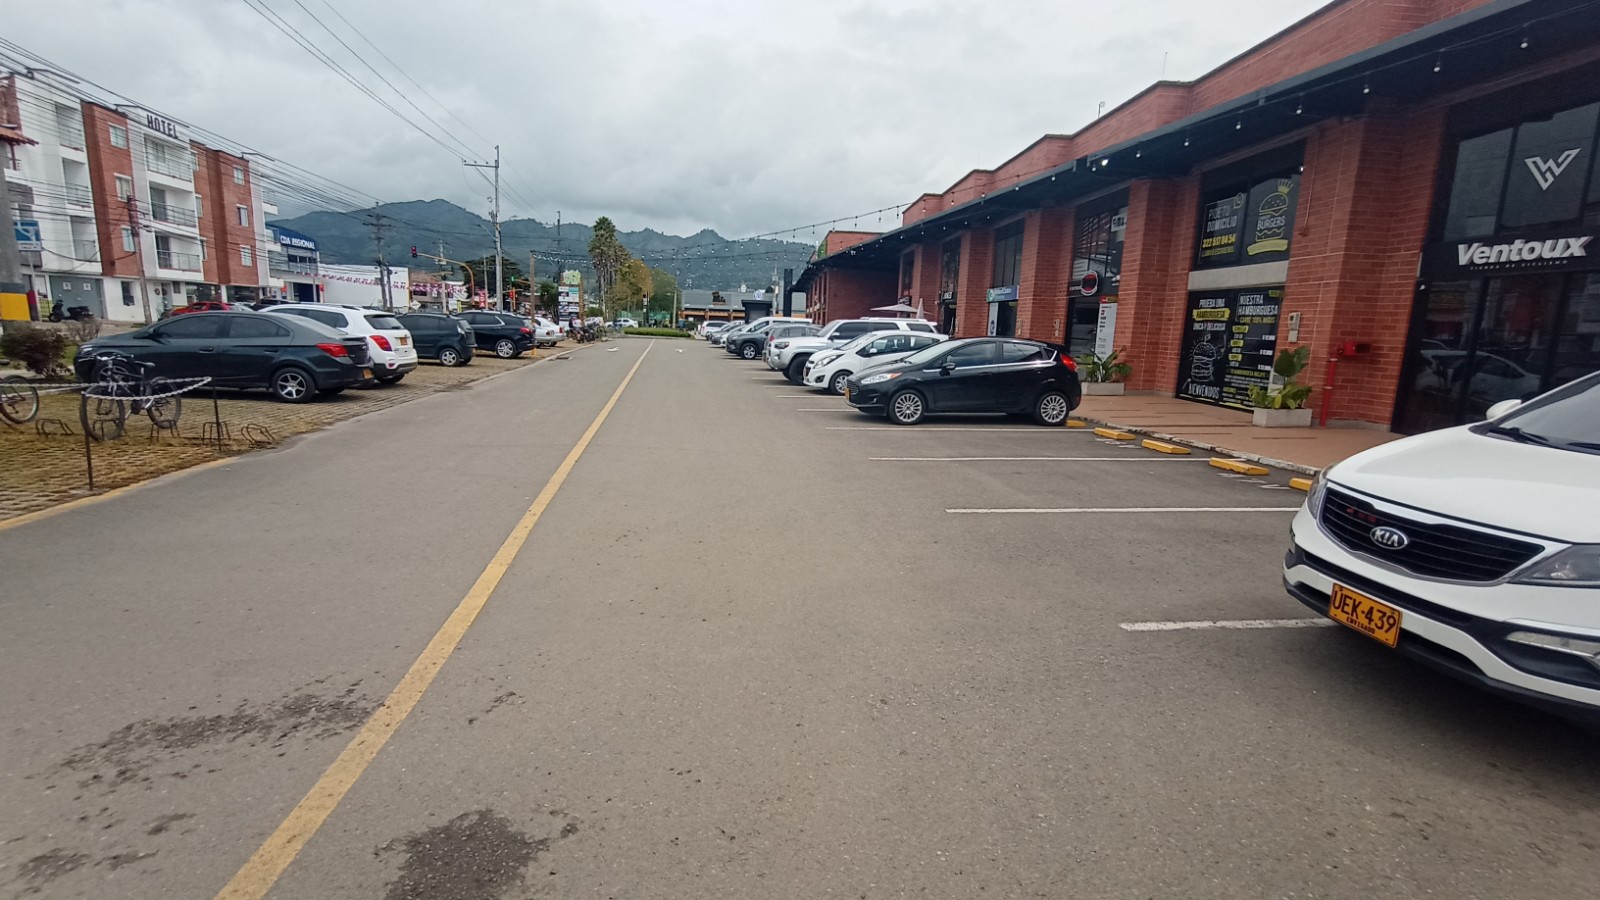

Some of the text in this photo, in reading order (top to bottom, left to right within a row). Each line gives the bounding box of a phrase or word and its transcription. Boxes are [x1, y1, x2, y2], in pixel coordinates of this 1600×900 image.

[147, 114, 179, 139] HOTEL
[1207, 215, 1238, 232] DOMICILIO
[1257, 215, 1286, 230] BURGERS
[281, 235, 316, 250] CDA REGIONAL
[1202, 238, 1212, 248] 322
[1458, 236, 1594, 266] Ventoux
[1240, 294, 1264, 305] NUESTRA
[1196, 310, 1225, 319] HAMBURGUESA
[1238, 305, 1278, 316] HAMBURGUESA
[1188, 383, 1220, 399] BIENVENIDOS
[1374, 529, 1399, 547] KIA
[1332, 589, 1397, 634] UEK-439
[1346, 616, 1376, 635] ENVIGADO
